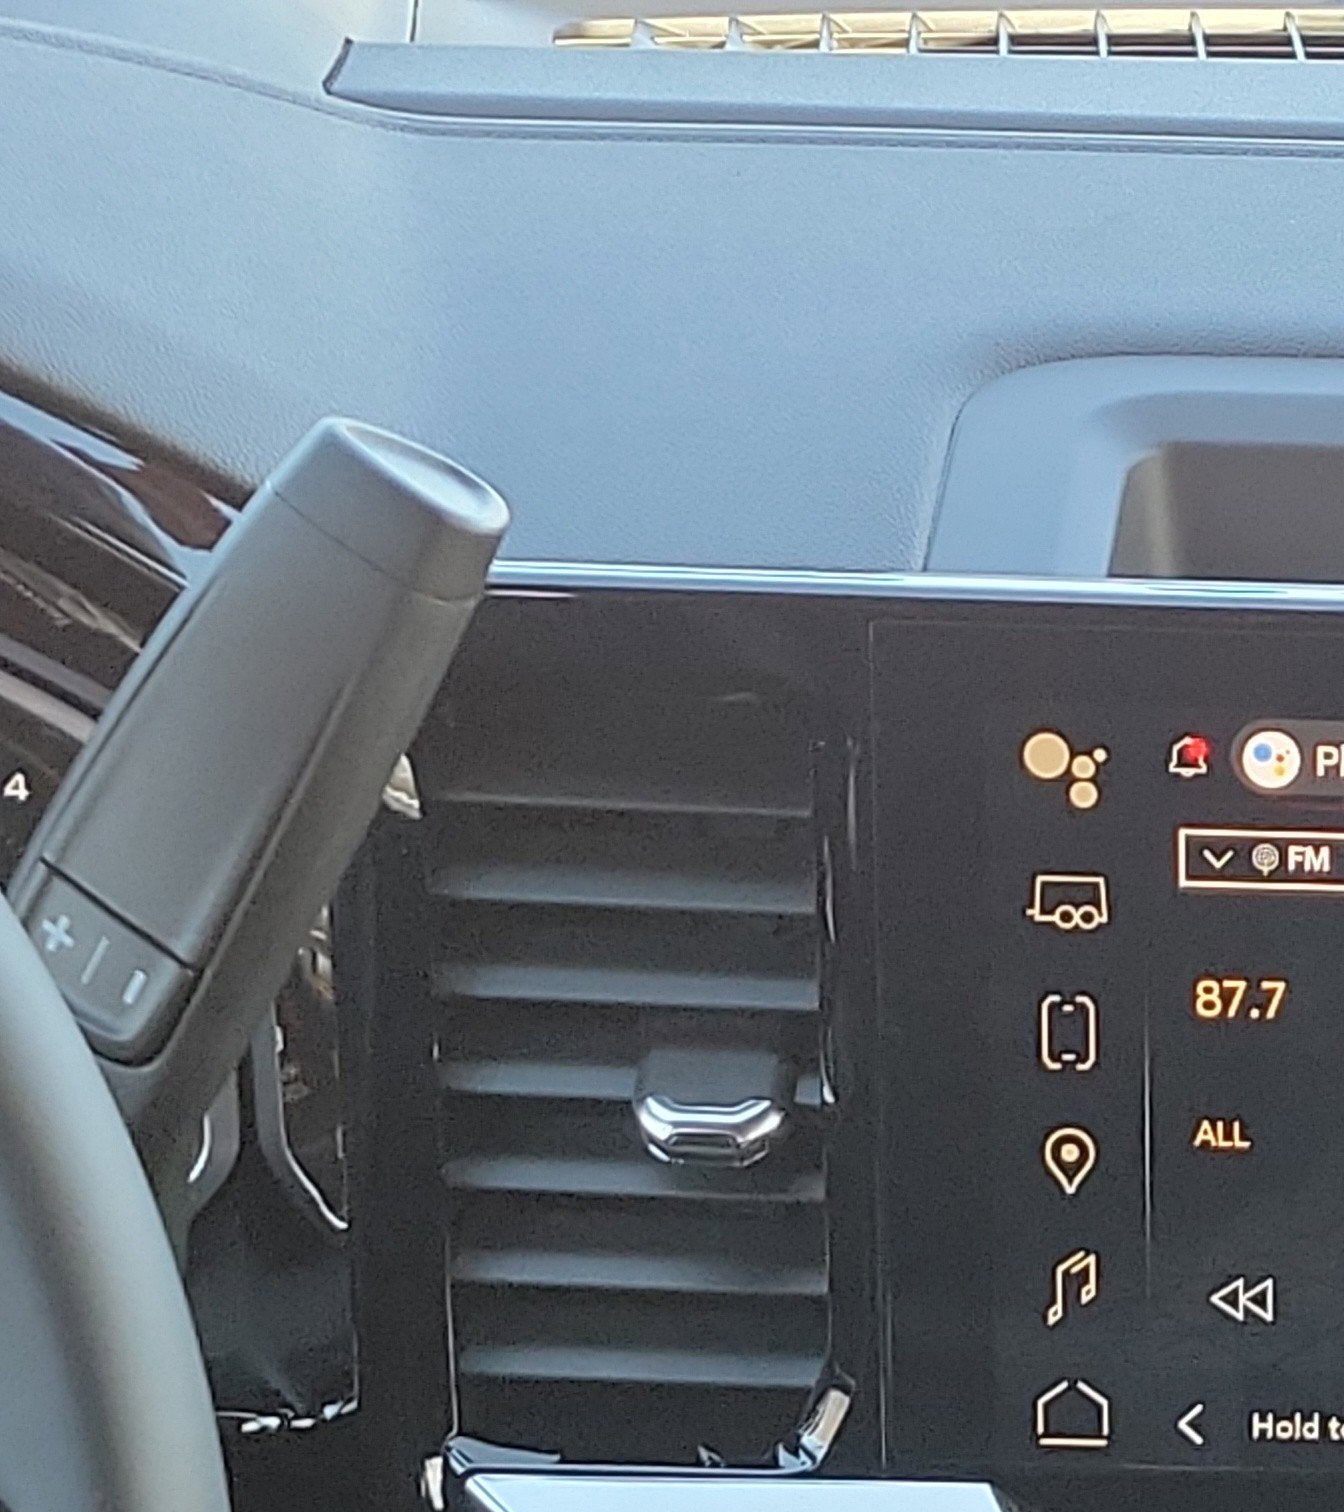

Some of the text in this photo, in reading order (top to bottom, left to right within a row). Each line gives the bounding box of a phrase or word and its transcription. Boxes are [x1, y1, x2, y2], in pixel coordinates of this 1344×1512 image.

[3, 772, 30, 802] 4
[1287, 845, 1331, 873] FM
[1194, 980, 1286, 1019] 87.7
[1194, 1121, 1251, 1148] ALL
[1251, 1411, 1320, 1441] Hold
